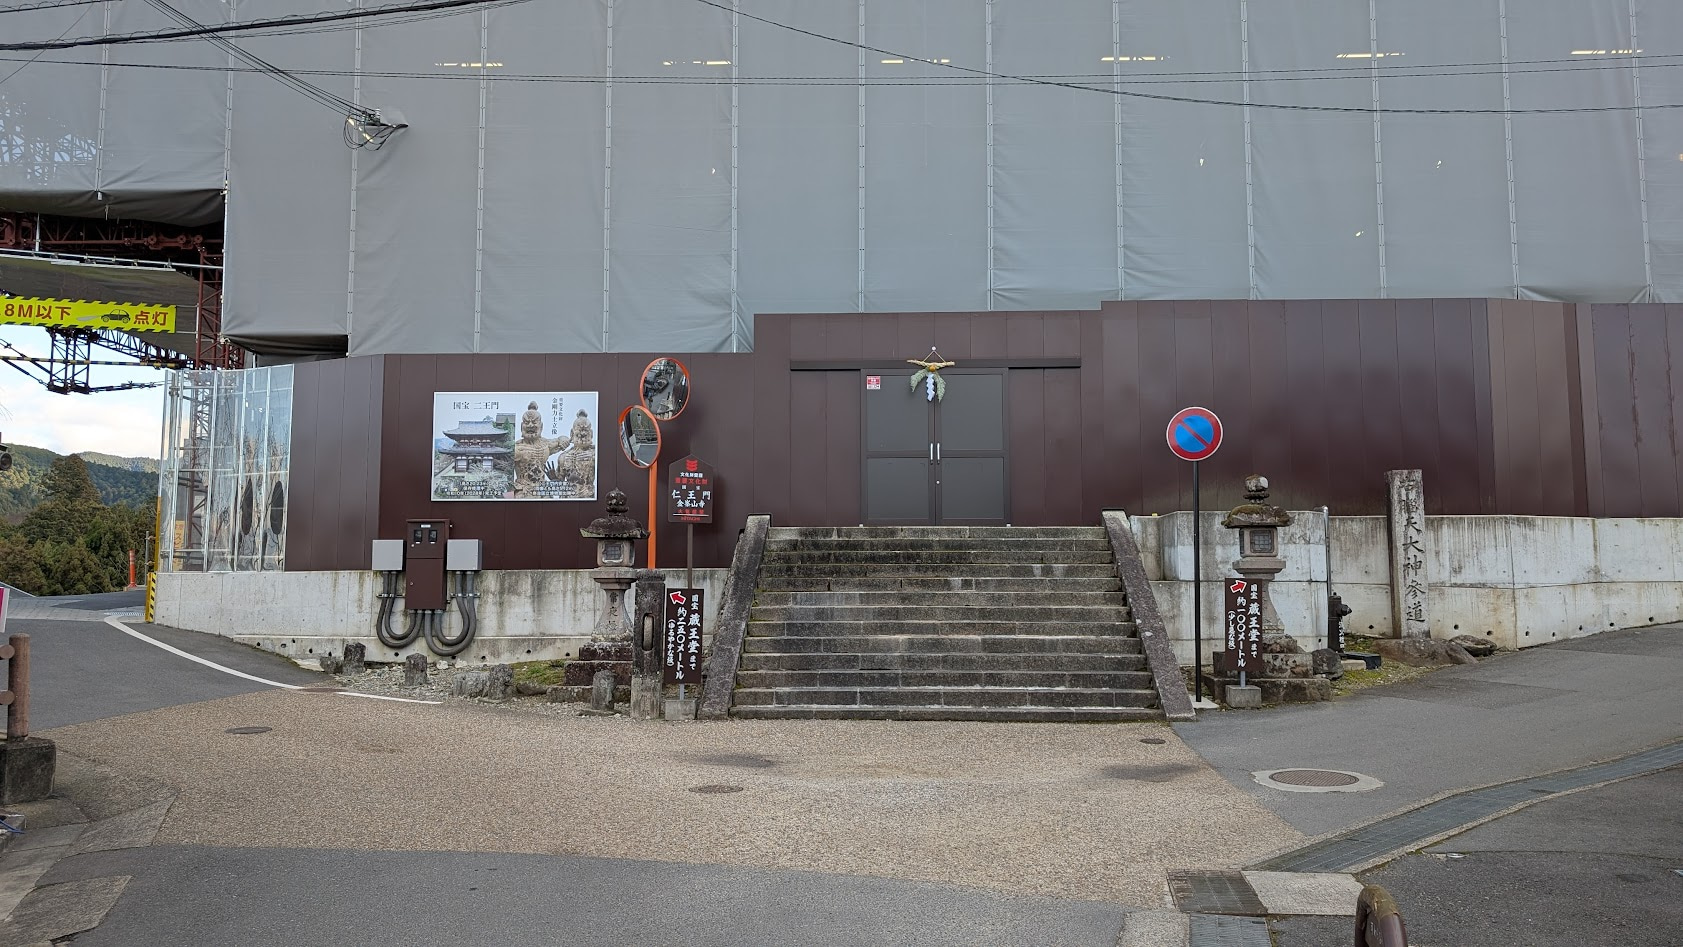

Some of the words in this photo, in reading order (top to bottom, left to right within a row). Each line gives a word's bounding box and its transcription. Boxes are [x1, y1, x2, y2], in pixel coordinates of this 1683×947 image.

[133, 310, 169, 327] 点灯
[473, 401, 499, 410] 二王門
